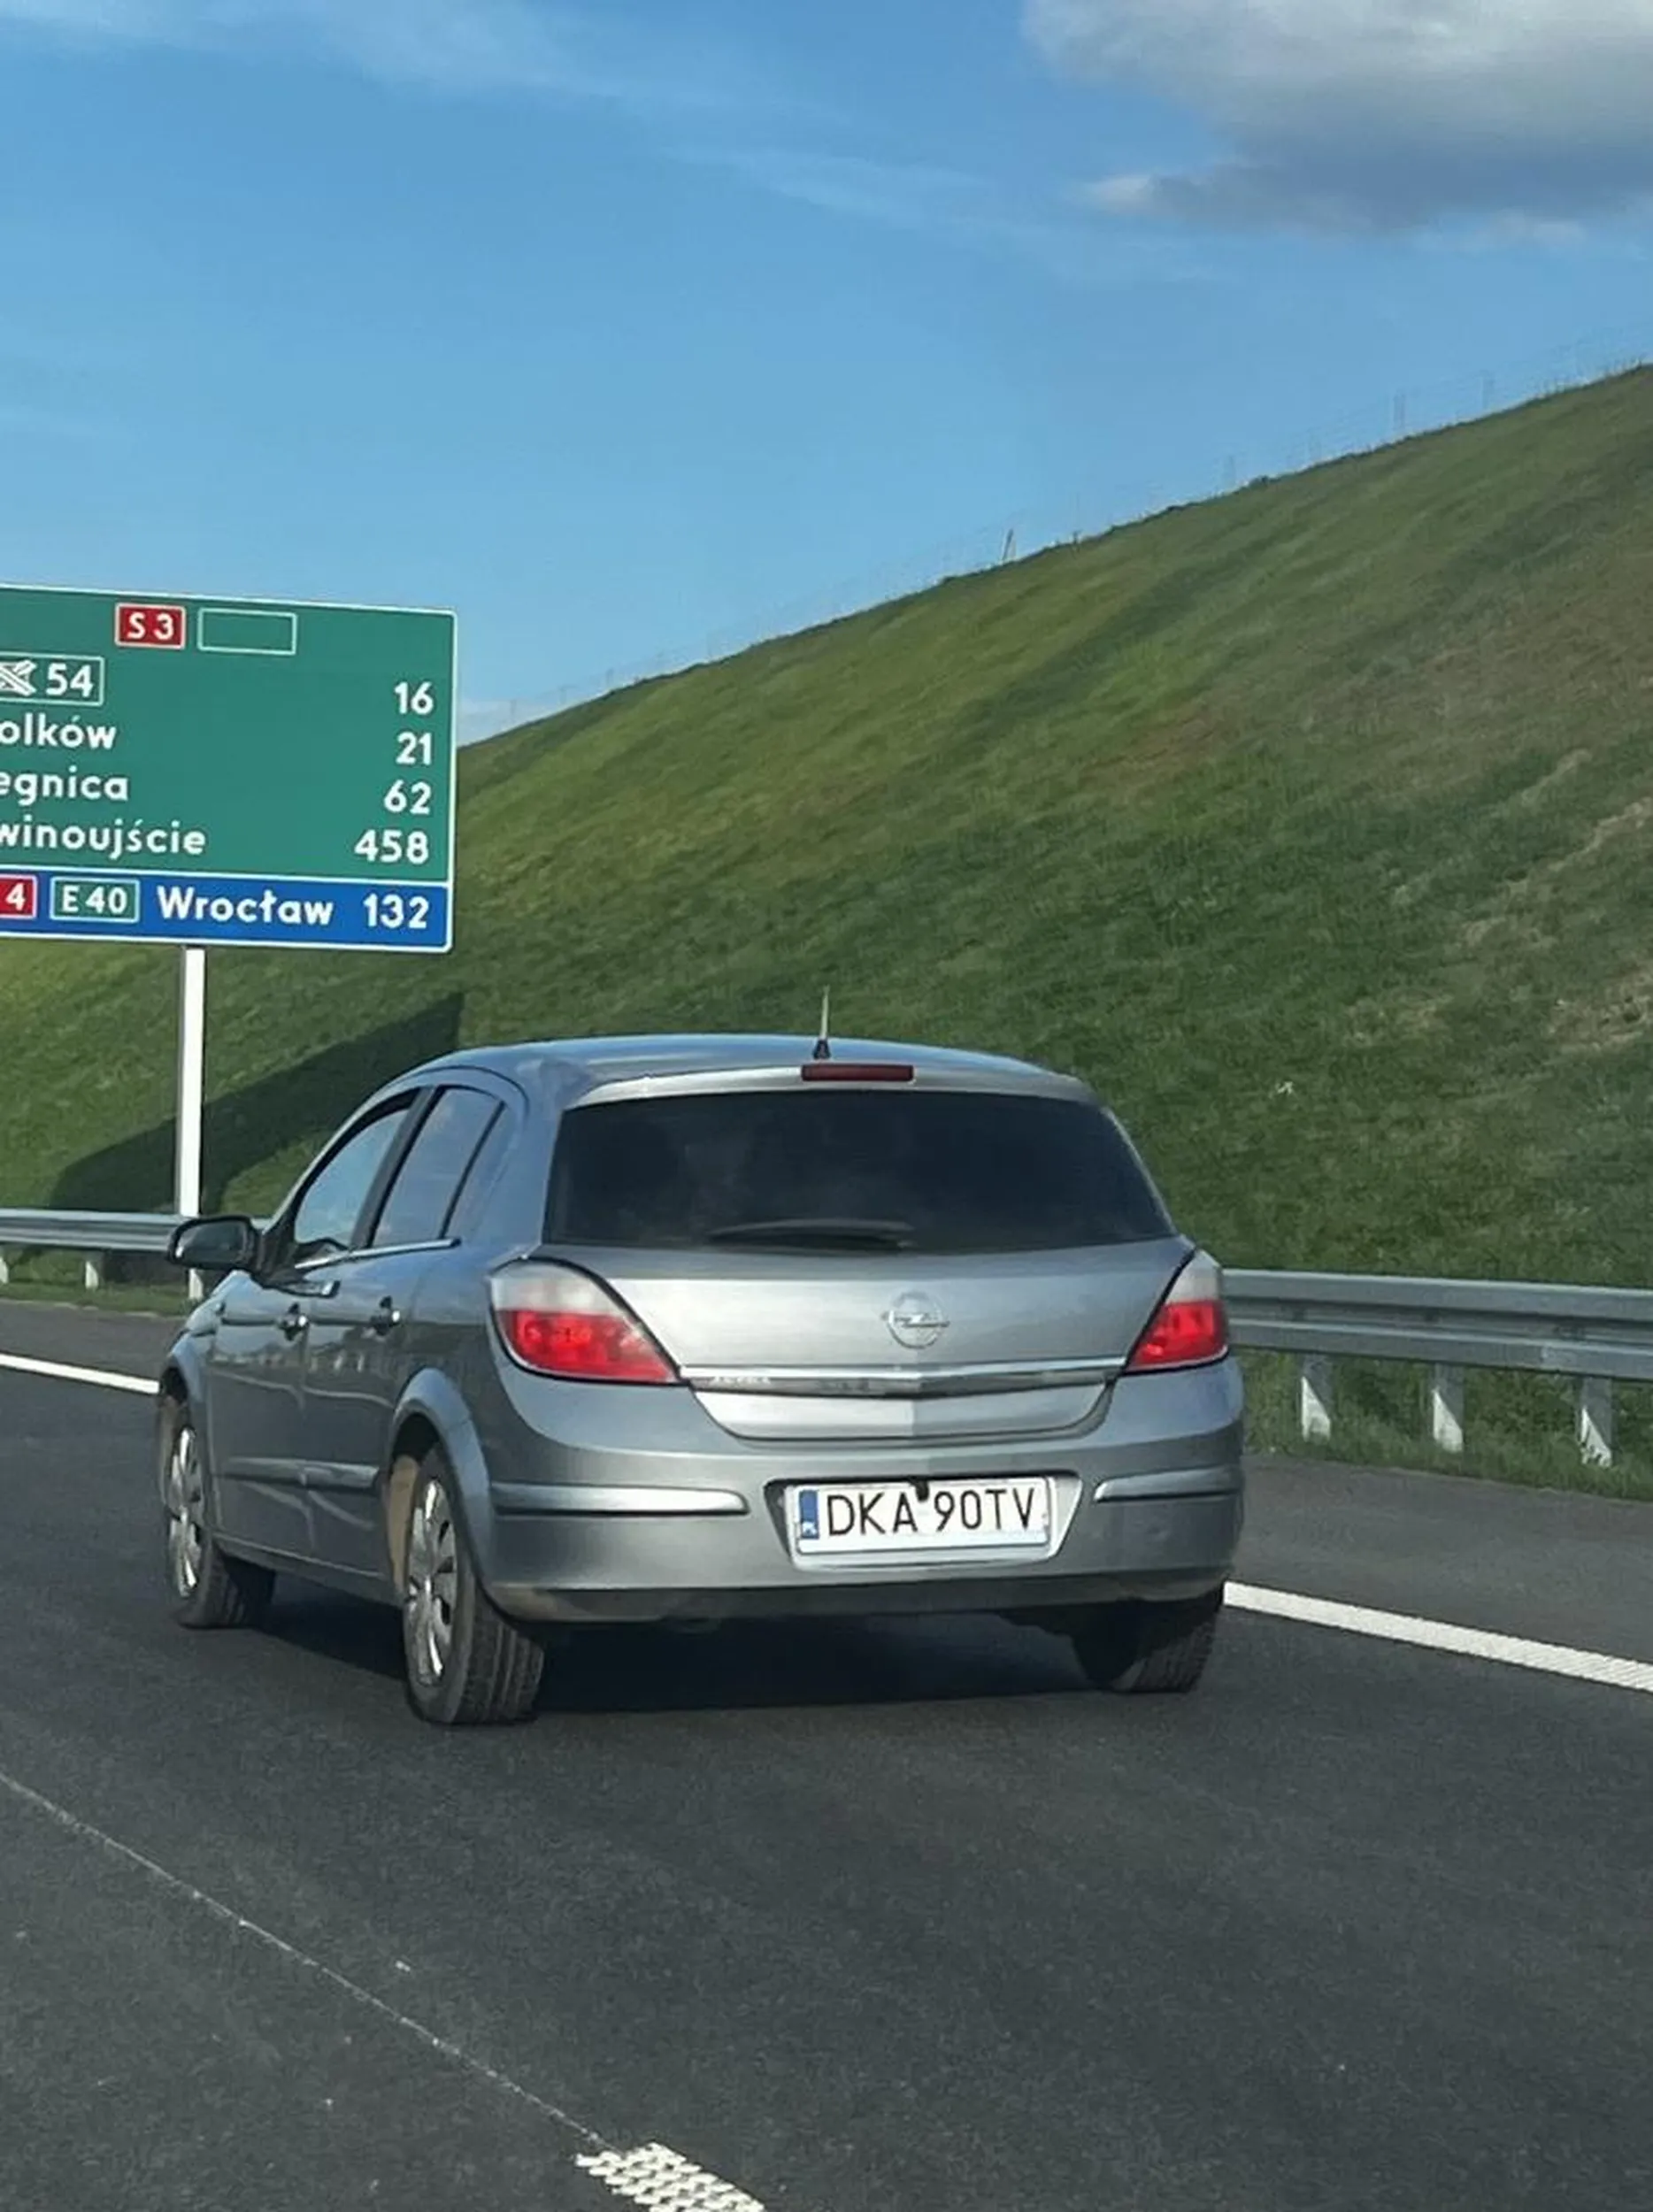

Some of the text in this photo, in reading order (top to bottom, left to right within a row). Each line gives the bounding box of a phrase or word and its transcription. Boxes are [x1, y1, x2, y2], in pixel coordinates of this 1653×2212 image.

[46, 663, 434, 714] 54 16
[0, 712, 432, 765] olków 21
[384, 780, 432, 815] 62
[355, 829, 429, 864] 458
[158, 885, 334, 926] Wrocław
[364, 892, 429, 929] 132
[826, 1486, 1034, 1536] DKA 90TV
